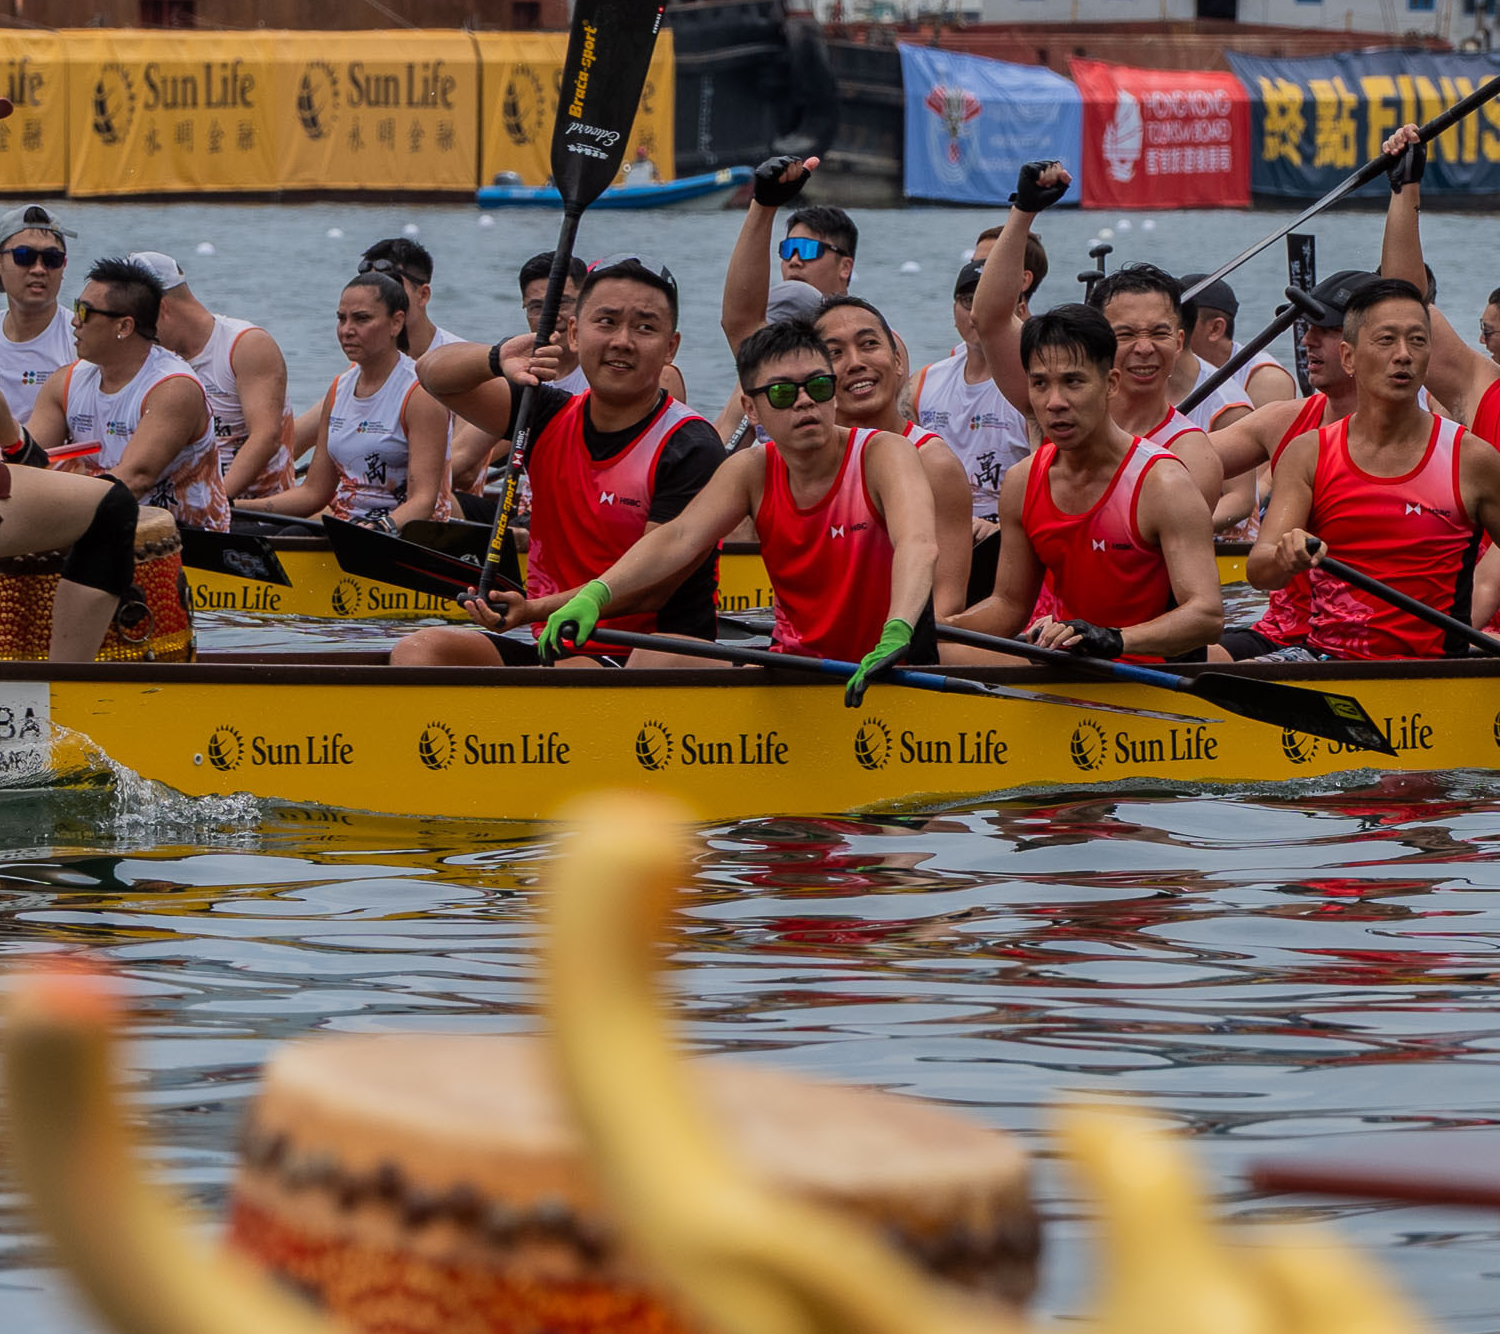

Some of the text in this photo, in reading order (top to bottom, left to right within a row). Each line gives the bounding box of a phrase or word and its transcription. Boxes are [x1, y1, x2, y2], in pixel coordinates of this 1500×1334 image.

[143, 56, 255, 110] Sun Life
[347, 60, 456, 109] Sun Life
[1188, 89, 1232, 116] KONG
[1259, 76, 1359, 168] 終點
[515, 429, 526, 449] HSBC
[365, 452, 388, 485] 萬
[974, 451, 1001, 491] 萬
[619, 496, 642, 508] HSBC
[196, 584, 282, 611] Sun Life
[367, 586, 408, 611] Sun
[251, 732, 355, 766] Sun Life
[463, 731, 571, 765] Sun Life
[681, 730, 789, 765] Sun Life
[900, 728, 1008, 764] Sun Life
[1114, 725, 1219, 763] Sun Life
[1383, 713, 1434, 751] Life
